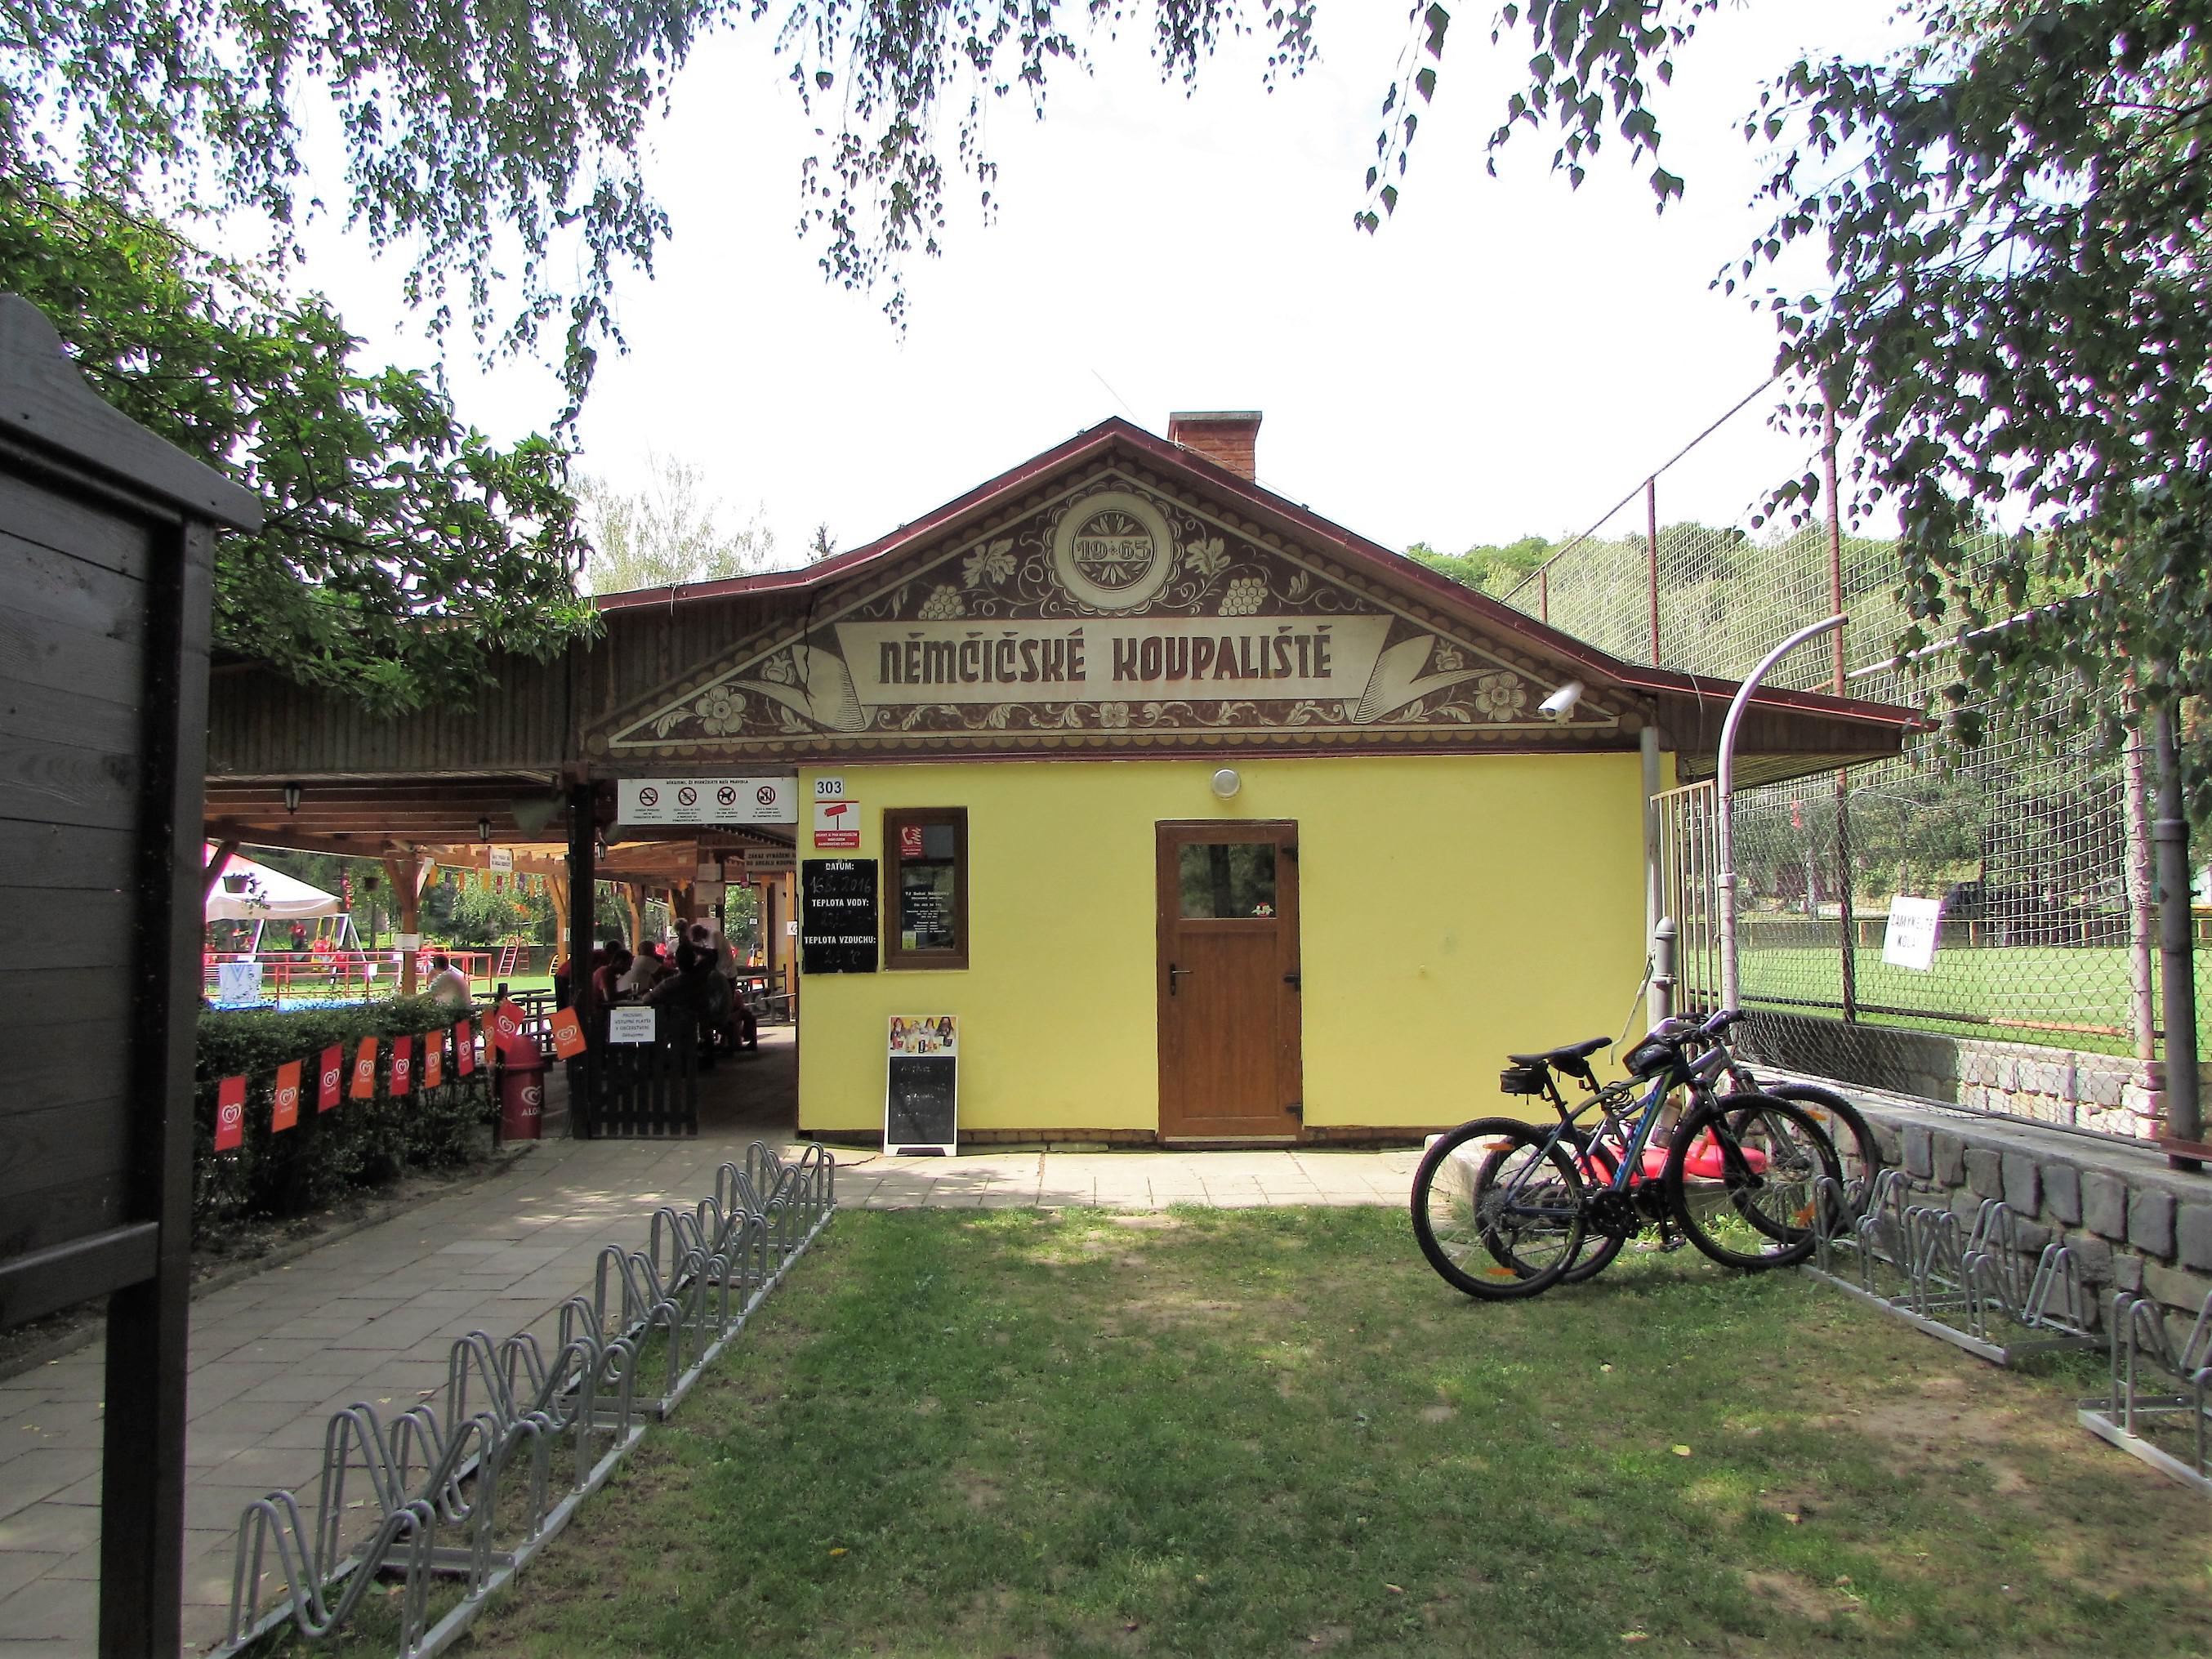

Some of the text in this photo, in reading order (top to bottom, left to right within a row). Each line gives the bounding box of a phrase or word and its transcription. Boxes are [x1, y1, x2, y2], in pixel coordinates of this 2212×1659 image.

[879, 626, 1332, 684] NĚMČIČSKÉ KOUPALIŠTĚ
[817, 781, 842, 794] 303
[825, 863, 854, 871] DATUM:
[812, 899, 869, 907] TEPLOTA VODY:
[804, 936, 876, 944] TEPLOTA VZDUCHU:
